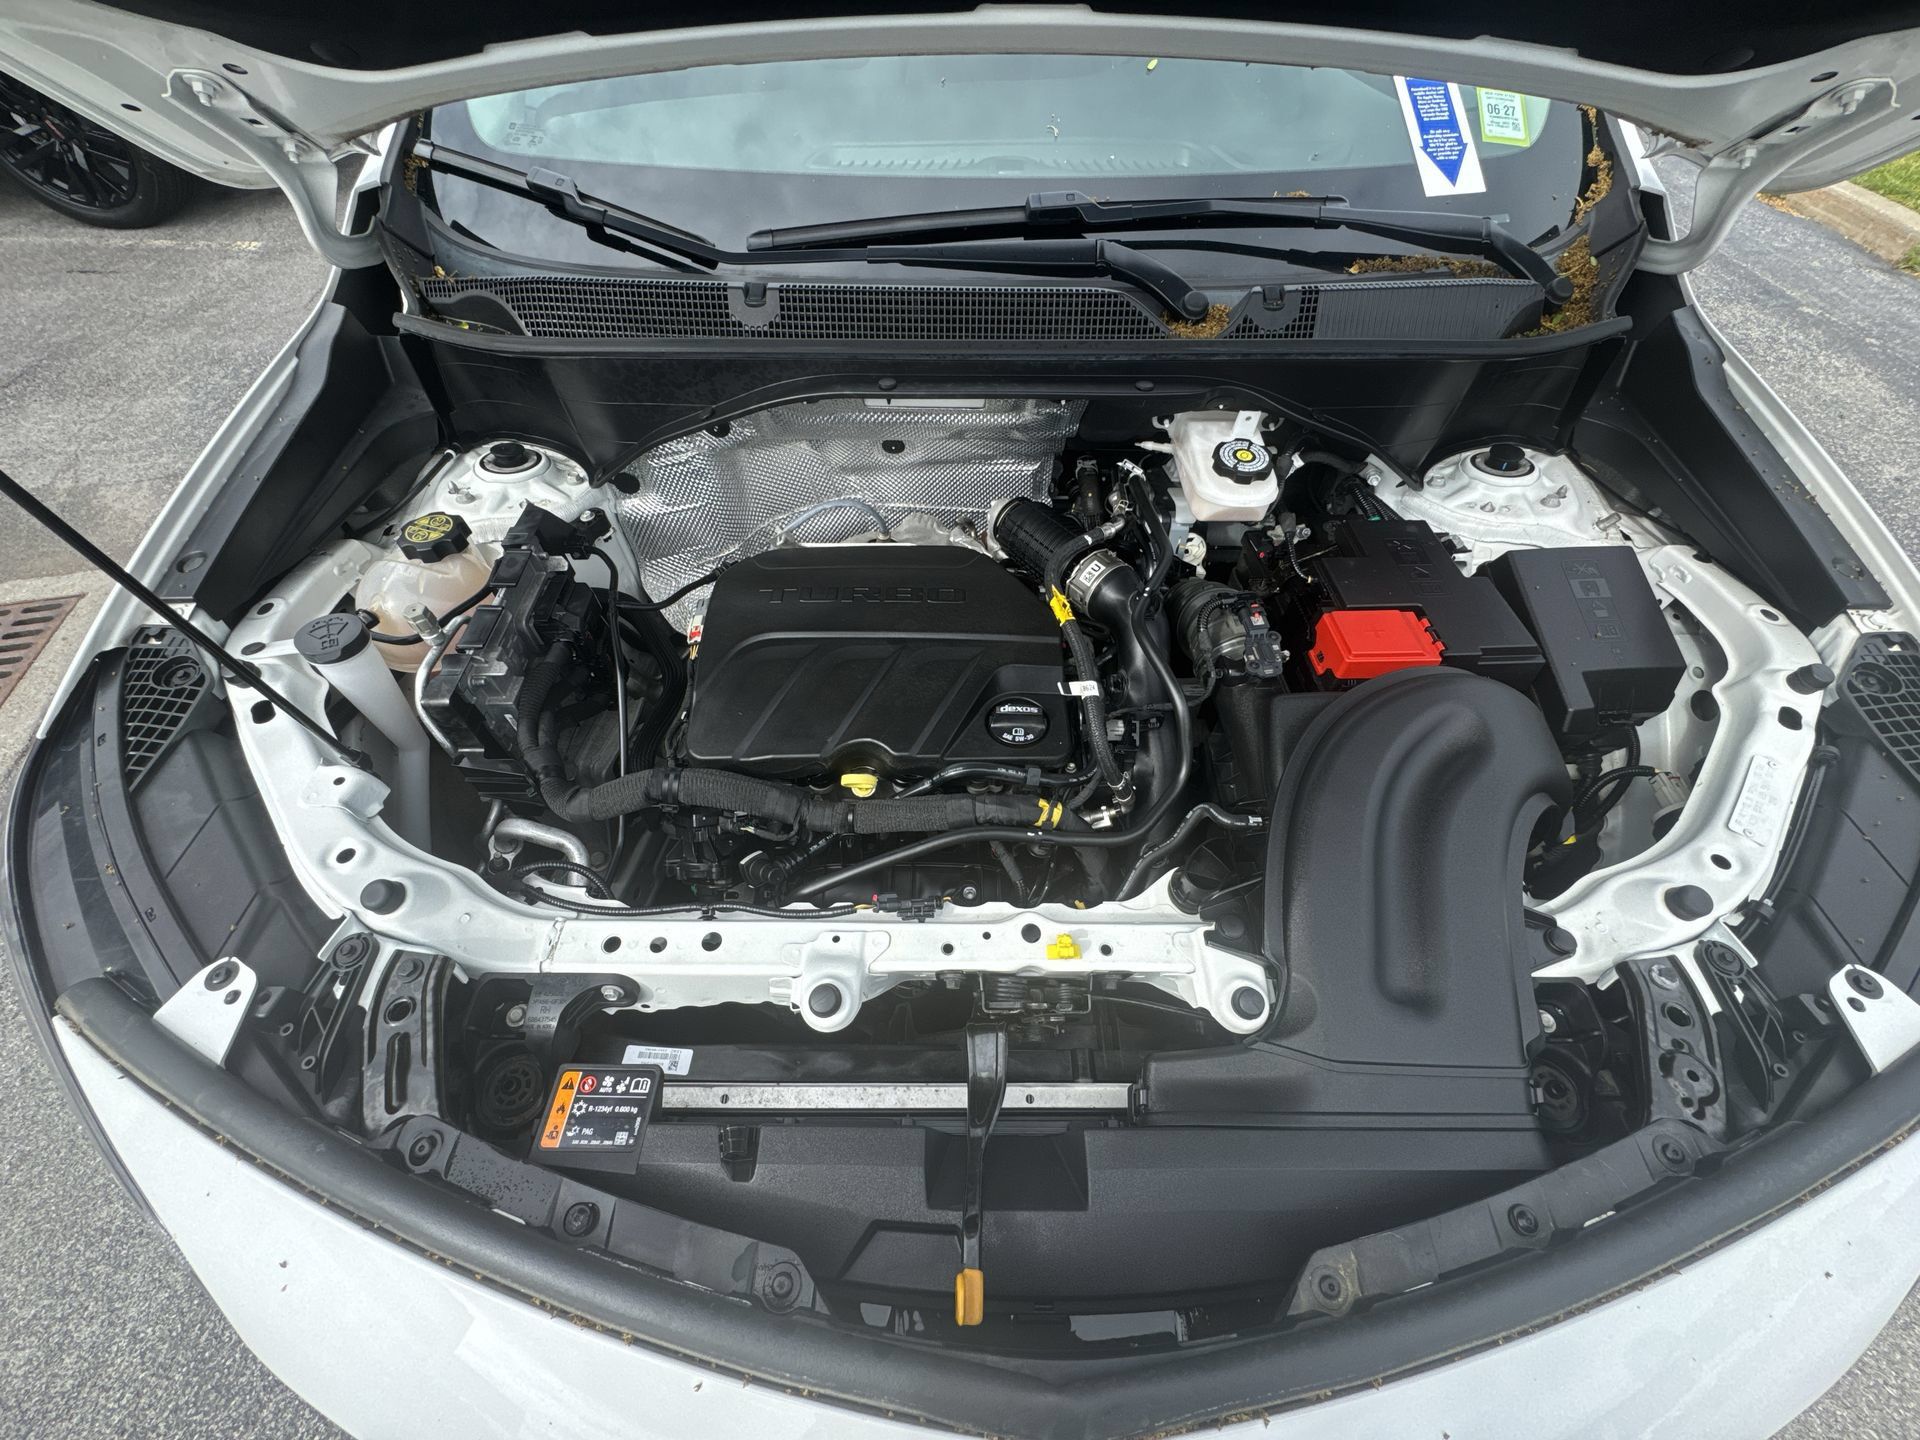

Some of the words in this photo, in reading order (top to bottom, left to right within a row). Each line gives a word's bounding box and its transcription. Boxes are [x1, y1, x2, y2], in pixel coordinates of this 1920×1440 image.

[1487, 103, 1501, 115] 06
[1503, 104, 1516, 117] 27
[759, 586, 967, 605] TURBO
[999, 703, 1039, 713] dexos
[1002, 732, 1013, 742] SAE
[1014, 733, 1035, 742] 5W-30
[588, 1105, 614, 1114] R-1234yf
[630, 1106, 639, 1114] kg
[581, 1128, 594, 1136] PAG
